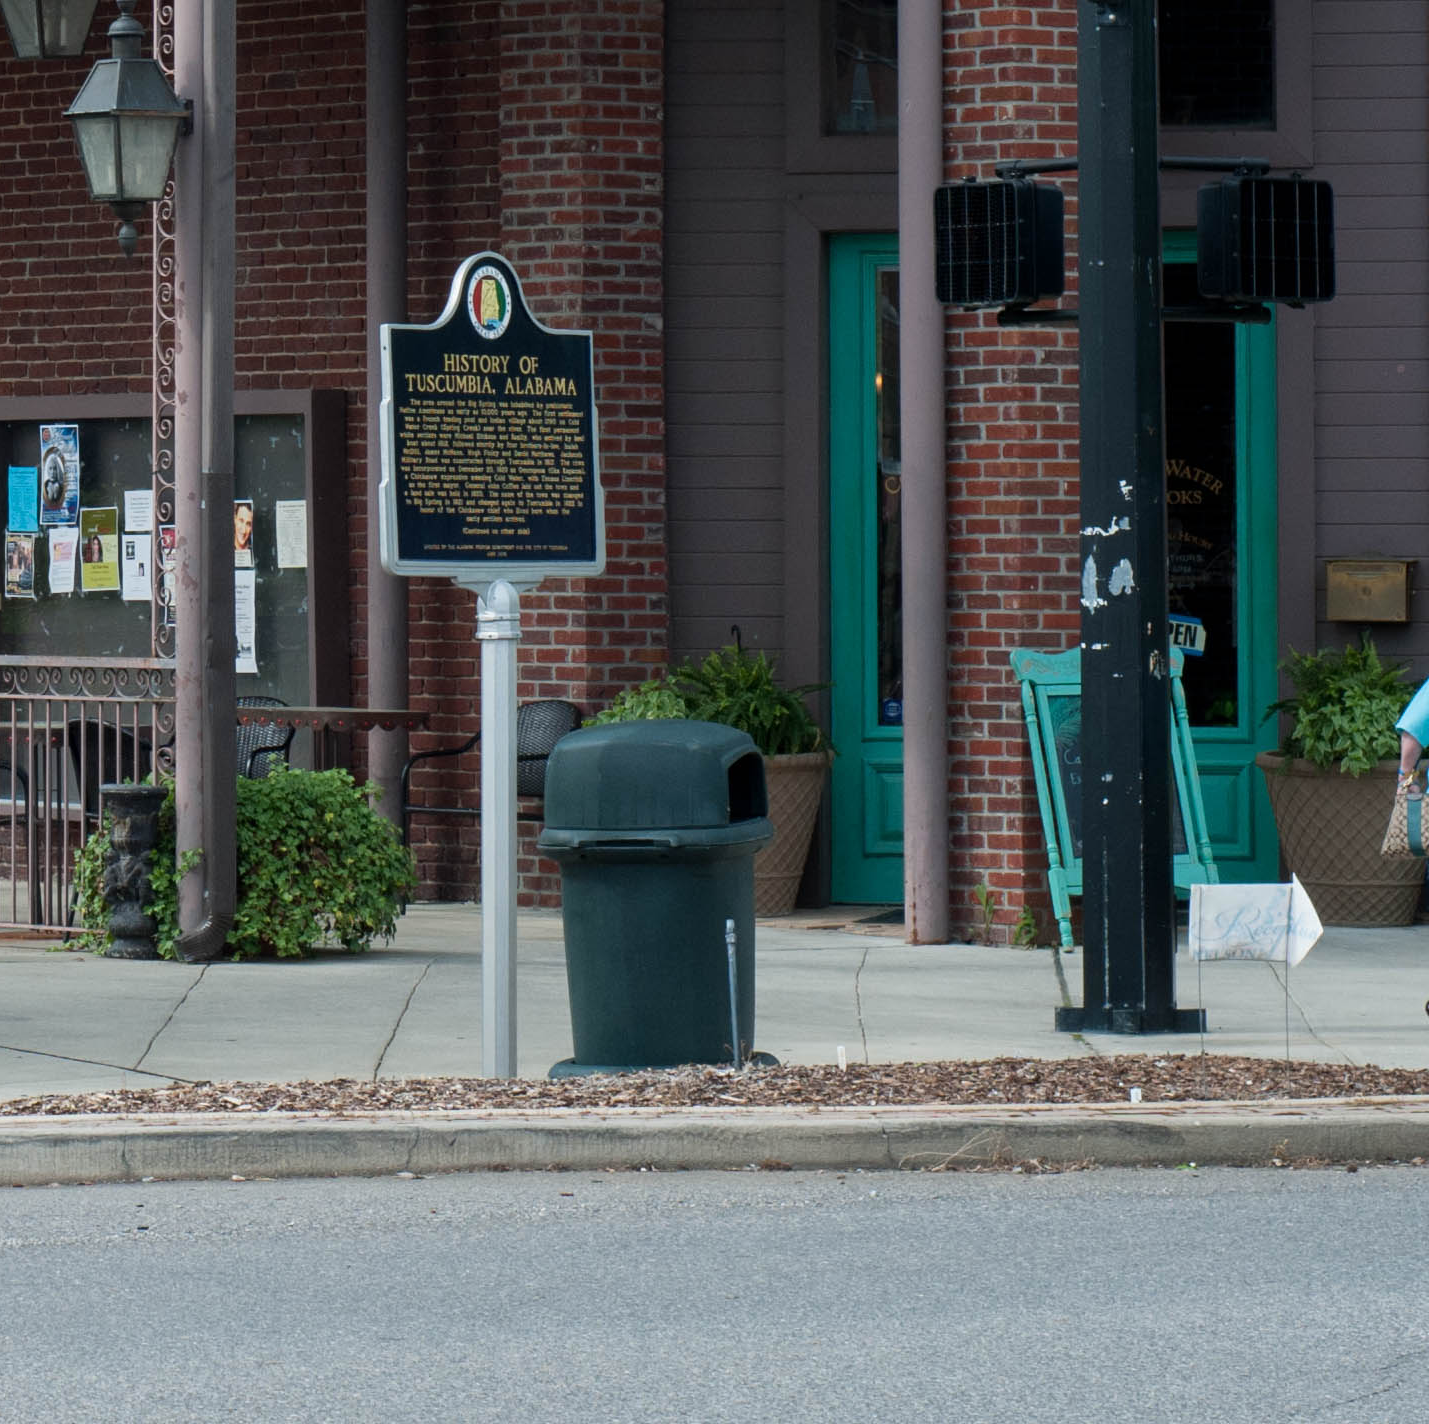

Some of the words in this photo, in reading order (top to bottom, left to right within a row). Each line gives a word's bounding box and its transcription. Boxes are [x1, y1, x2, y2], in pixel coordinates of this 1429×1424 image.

[444, 353, 510, 373] HISTORY
[519, 356, 539, 374] OF
[405, 373, 497, 394] TUSCUMBIA,
[505, 377, 577, 396] ALABAMA
[1166, 489, 1203, 505] OKS
